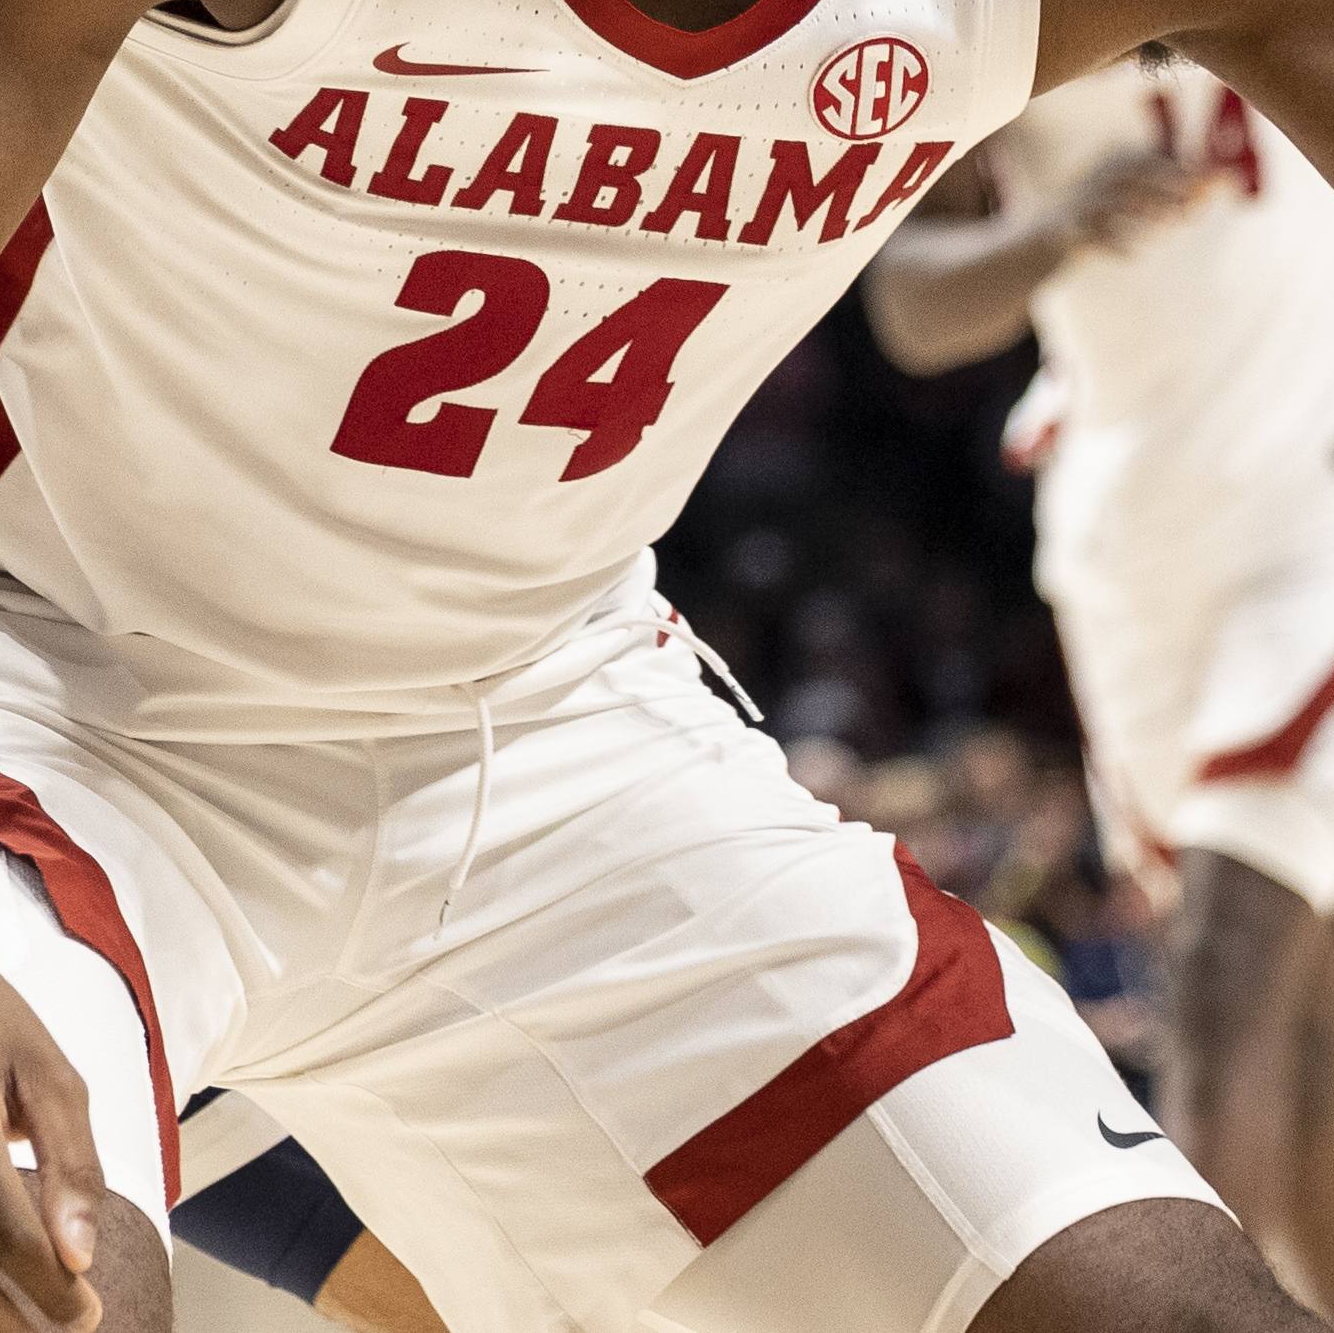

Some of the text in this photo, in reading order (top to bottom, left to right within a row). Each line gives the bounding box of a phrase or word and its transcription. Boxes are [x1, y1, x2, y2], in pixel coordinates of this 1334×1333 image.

[268, 87, 956, 246] ALABAMA
[820, 41, 924, 136] SEC
[330, 249, 730, 482] 24
